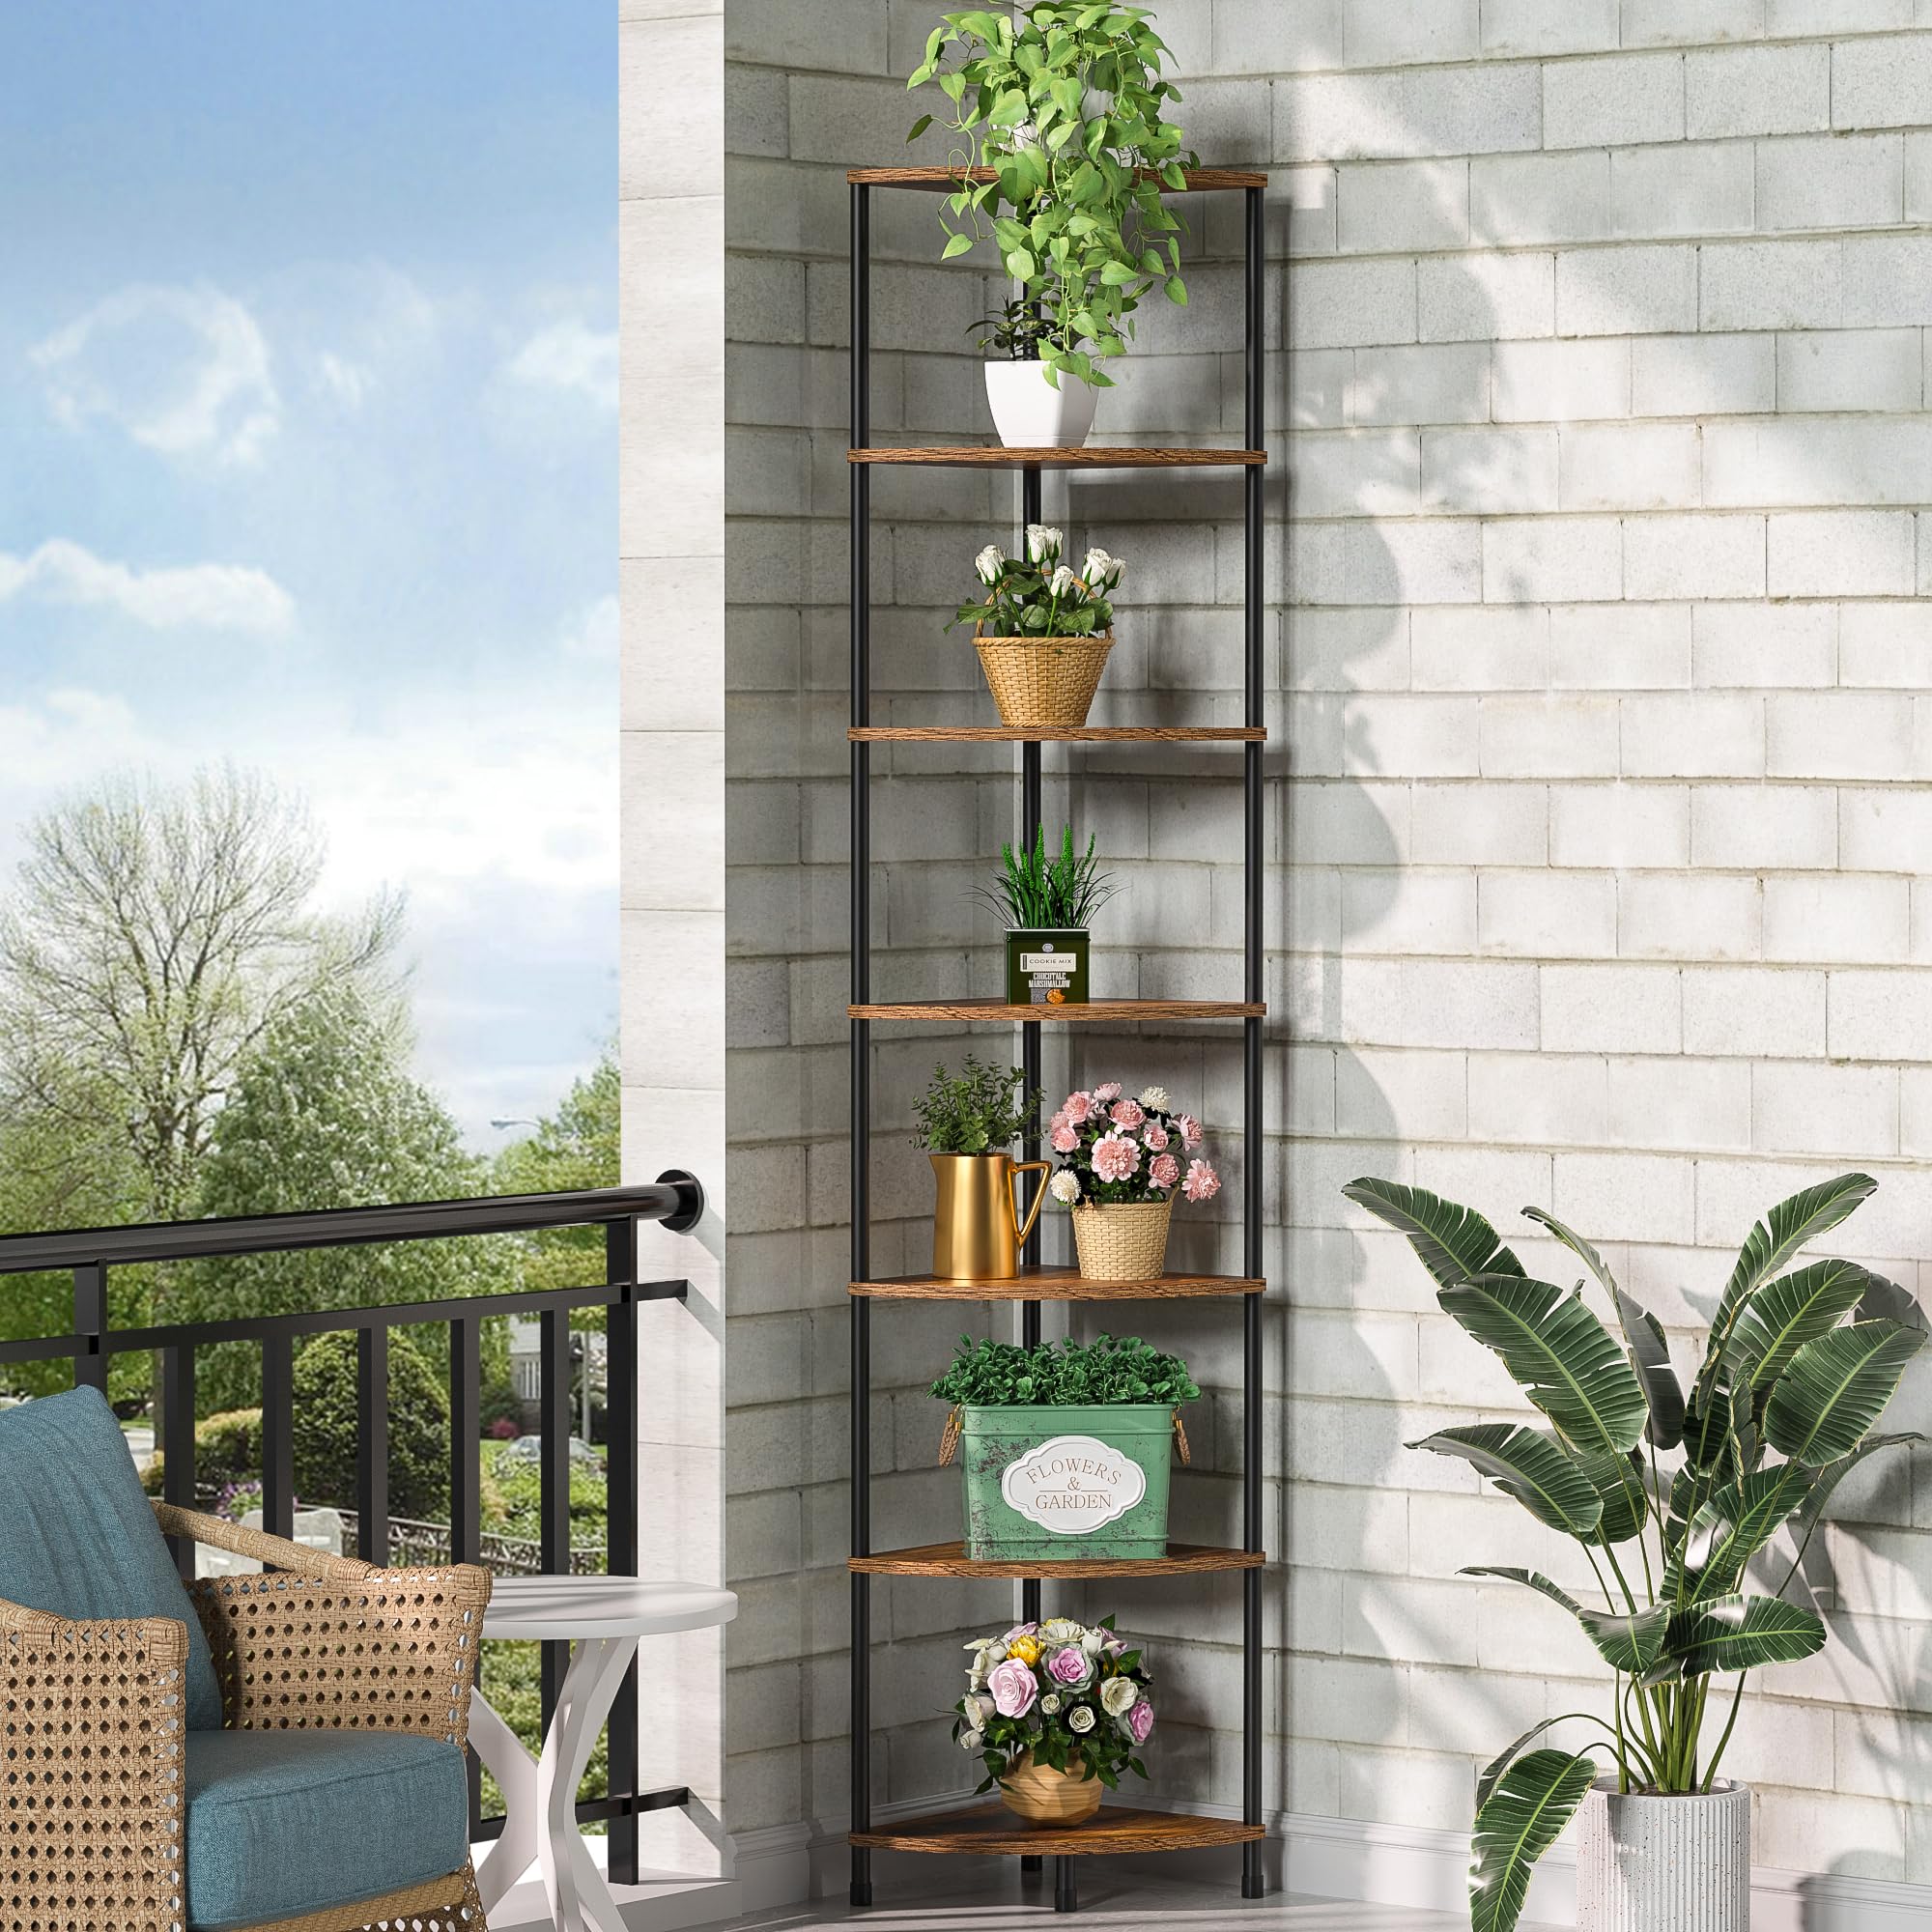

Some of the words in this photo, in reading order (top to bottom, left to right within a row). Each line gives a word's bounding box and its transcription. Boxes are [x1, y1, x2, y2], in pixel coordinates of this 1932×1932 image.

[1028, 980, 1070, 988] MARSHMALLOW
[1026, 1458, 1122, 1486] FLOWERS
[1066, 1476, 1081, 1491] &
[1036, 1494, 1113, 1509] GARDEN
